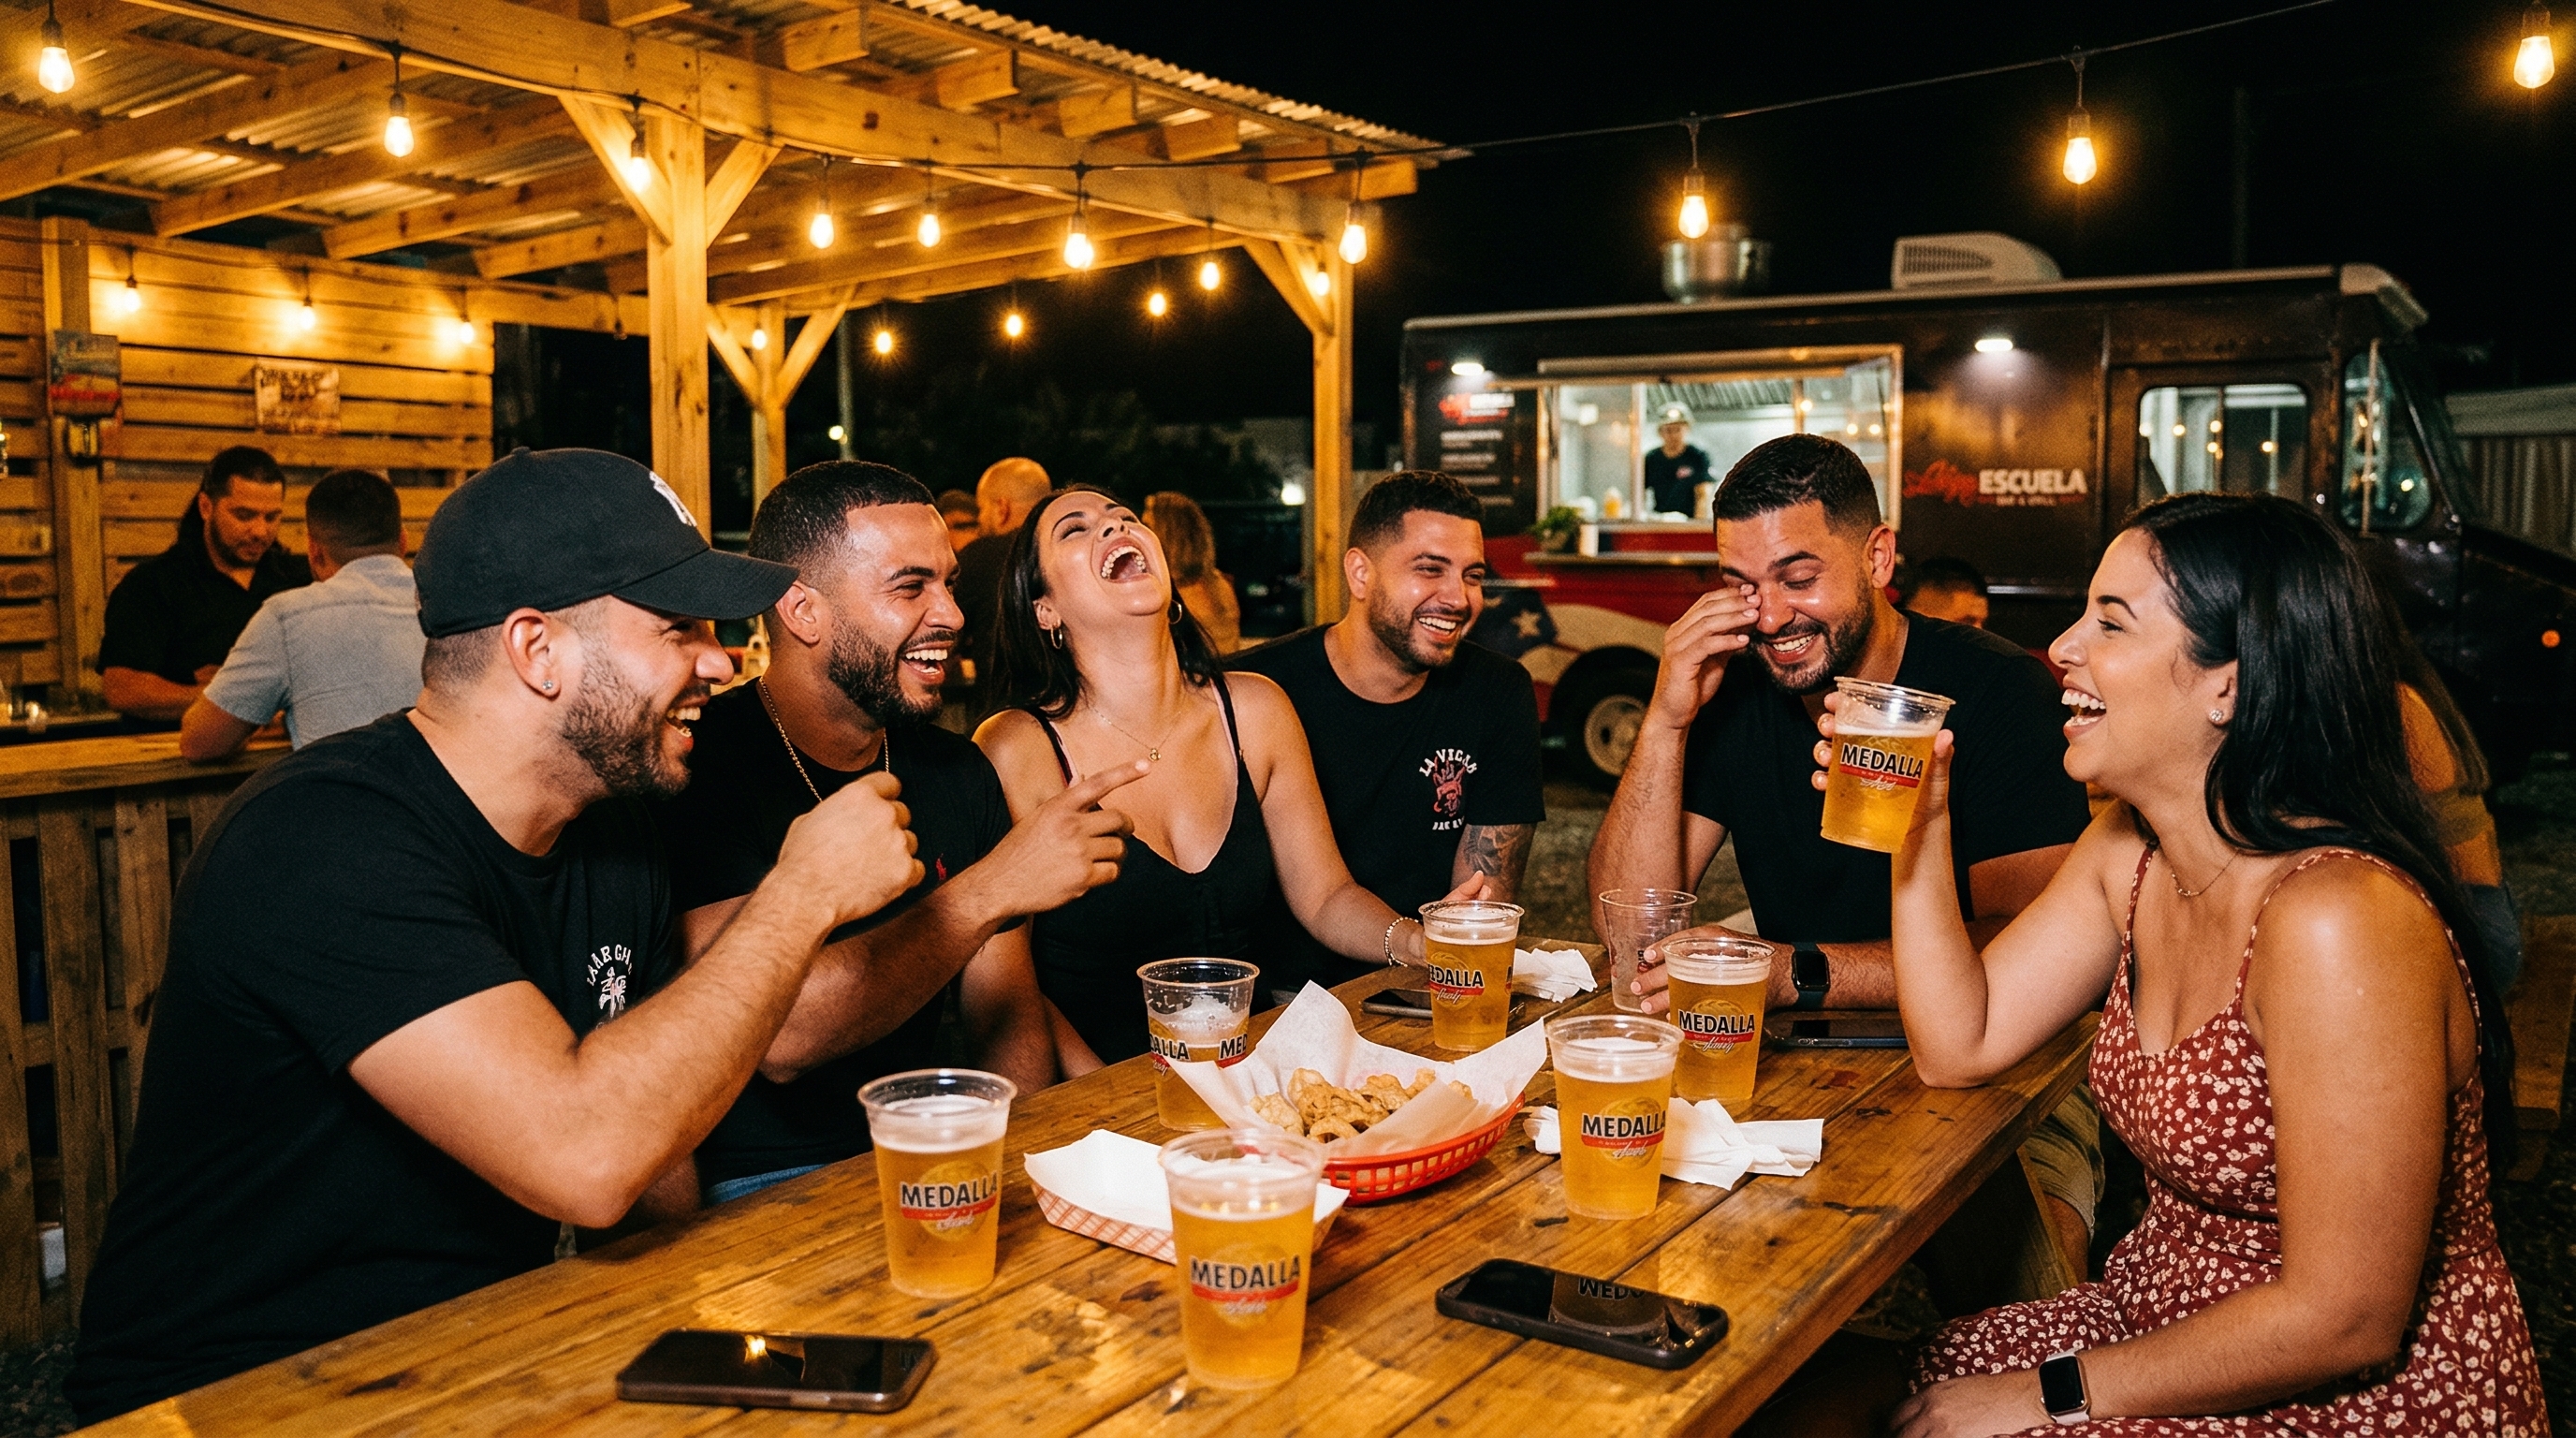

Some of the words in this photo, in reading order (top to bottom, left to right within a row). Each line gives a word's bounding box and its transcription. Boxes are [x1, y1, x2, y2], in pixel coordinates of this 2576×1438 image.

[1978, 468, 2088, 495] ESCUELA
[1840, 742, 1925, 780] MEDALLA
[1677, 1010, 1756, 1034] MEDALLA
[1581, 1109, 1666, 1138] MEDALLA
[900, 1170, 998, 1209] MEDALLA
[1191, 1255, 1300, 1291] MEDALLA
